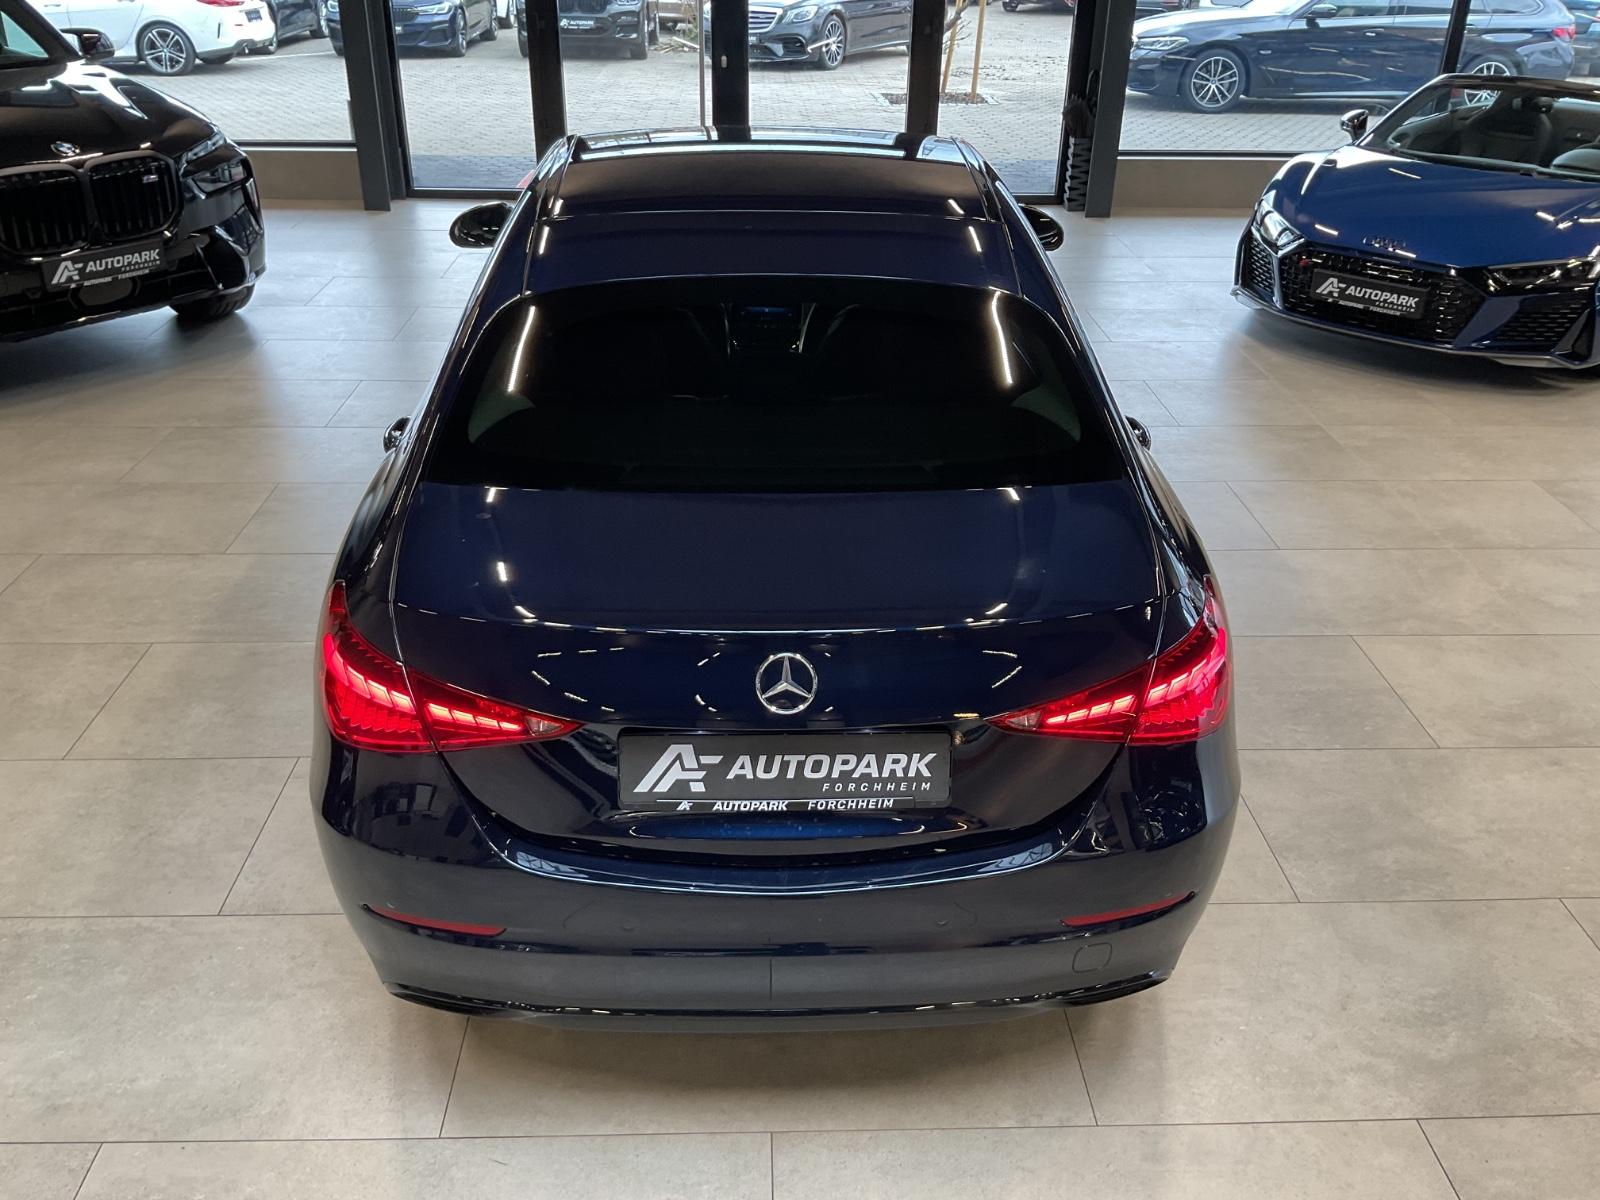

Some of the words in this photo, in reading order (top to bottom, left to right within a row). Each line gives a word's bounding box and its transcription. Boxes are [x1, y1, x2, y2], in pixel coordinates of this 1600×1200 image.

[85, 248, 160, 273] AUTOPARK
[1345, 285, 1420, 308] AUTOPARK
[726, 752, 937, 780] AUTOPARK
[822, 781, 932, 792] FORCHHEIM
[712, 800, 789, 811] AUTOPARK
[807, 798, 894, 811] FORCHHEIM
